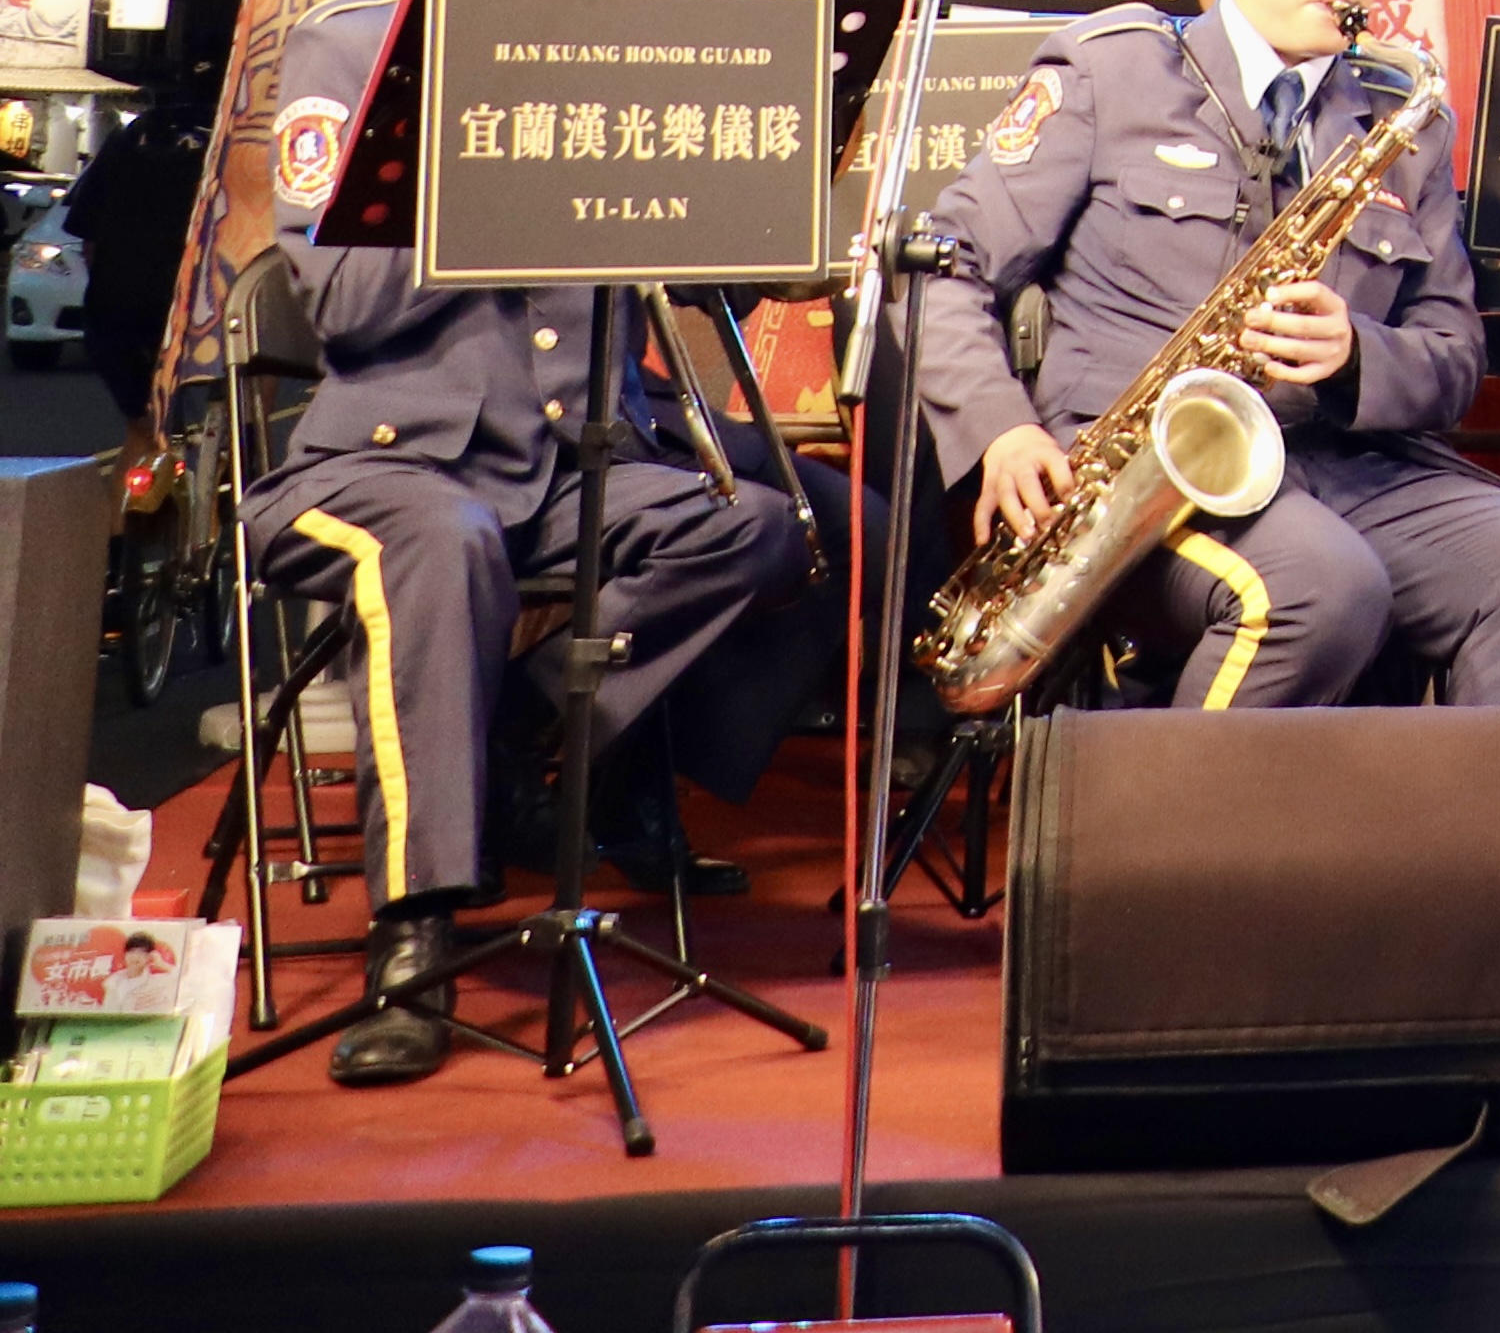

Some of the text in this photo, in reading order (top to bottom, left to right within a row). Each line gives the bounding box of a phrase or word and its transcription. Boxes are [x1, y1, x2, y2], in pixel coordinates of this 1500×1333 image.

[495, 43, 772, 66] HAN KUANG HONOR GUARD
[979, 74, 1030, 91] HON
[459, 101, 801, 162] 宜蘭漢光樂儀隊
[571, 197, 689, 220] YI-LAN
